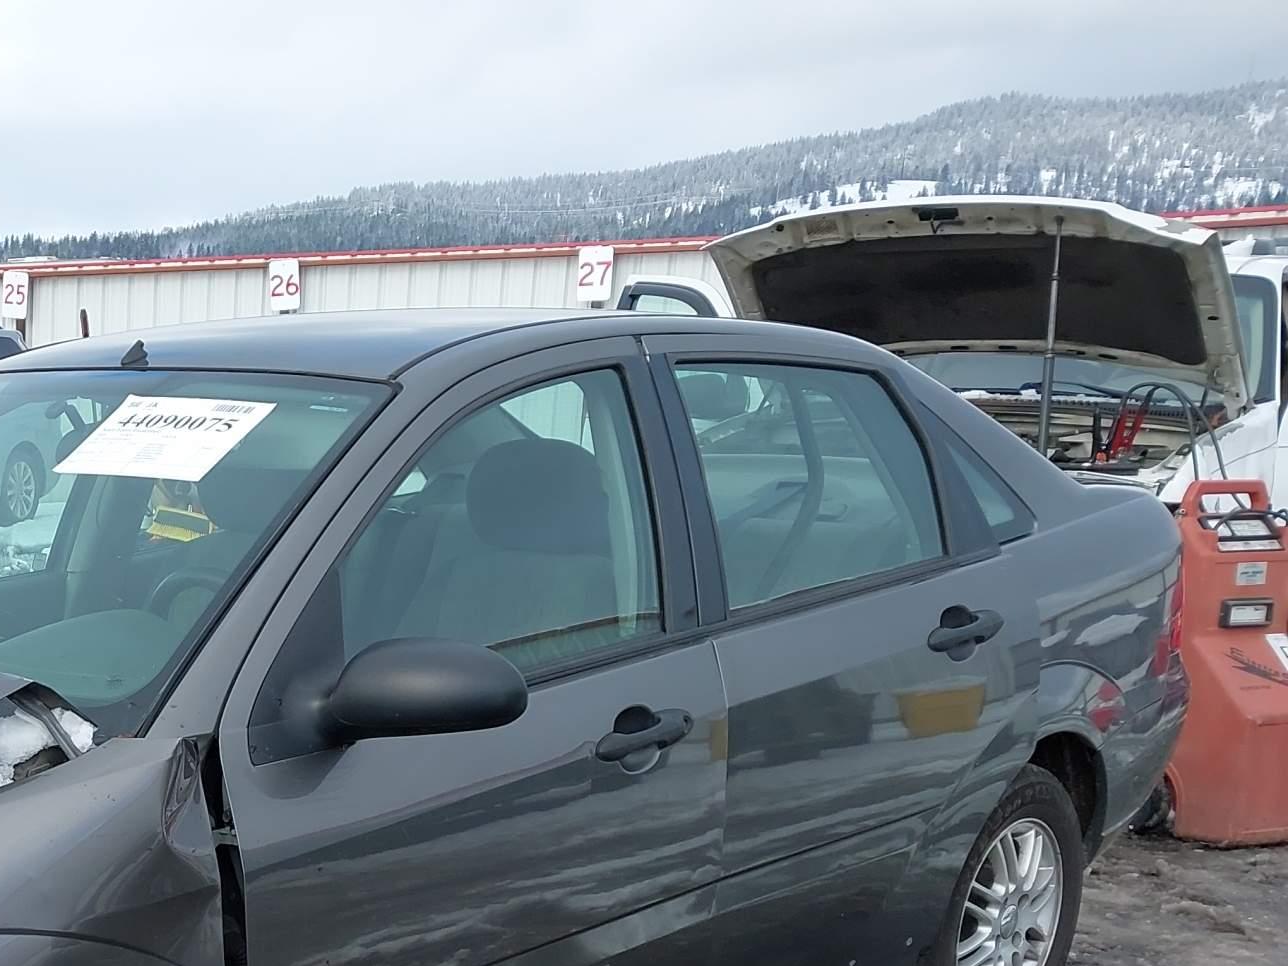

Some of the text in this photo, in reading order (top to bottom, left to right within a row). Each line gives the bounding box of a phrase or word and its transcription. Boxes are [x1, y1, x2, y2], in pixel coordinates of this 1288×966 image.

[578, 261, 612, 287] 27
[4, 283, 26, 305] 25
[270, 274, 300, 297] 26
[118, 413, 240, 433] 44090075
